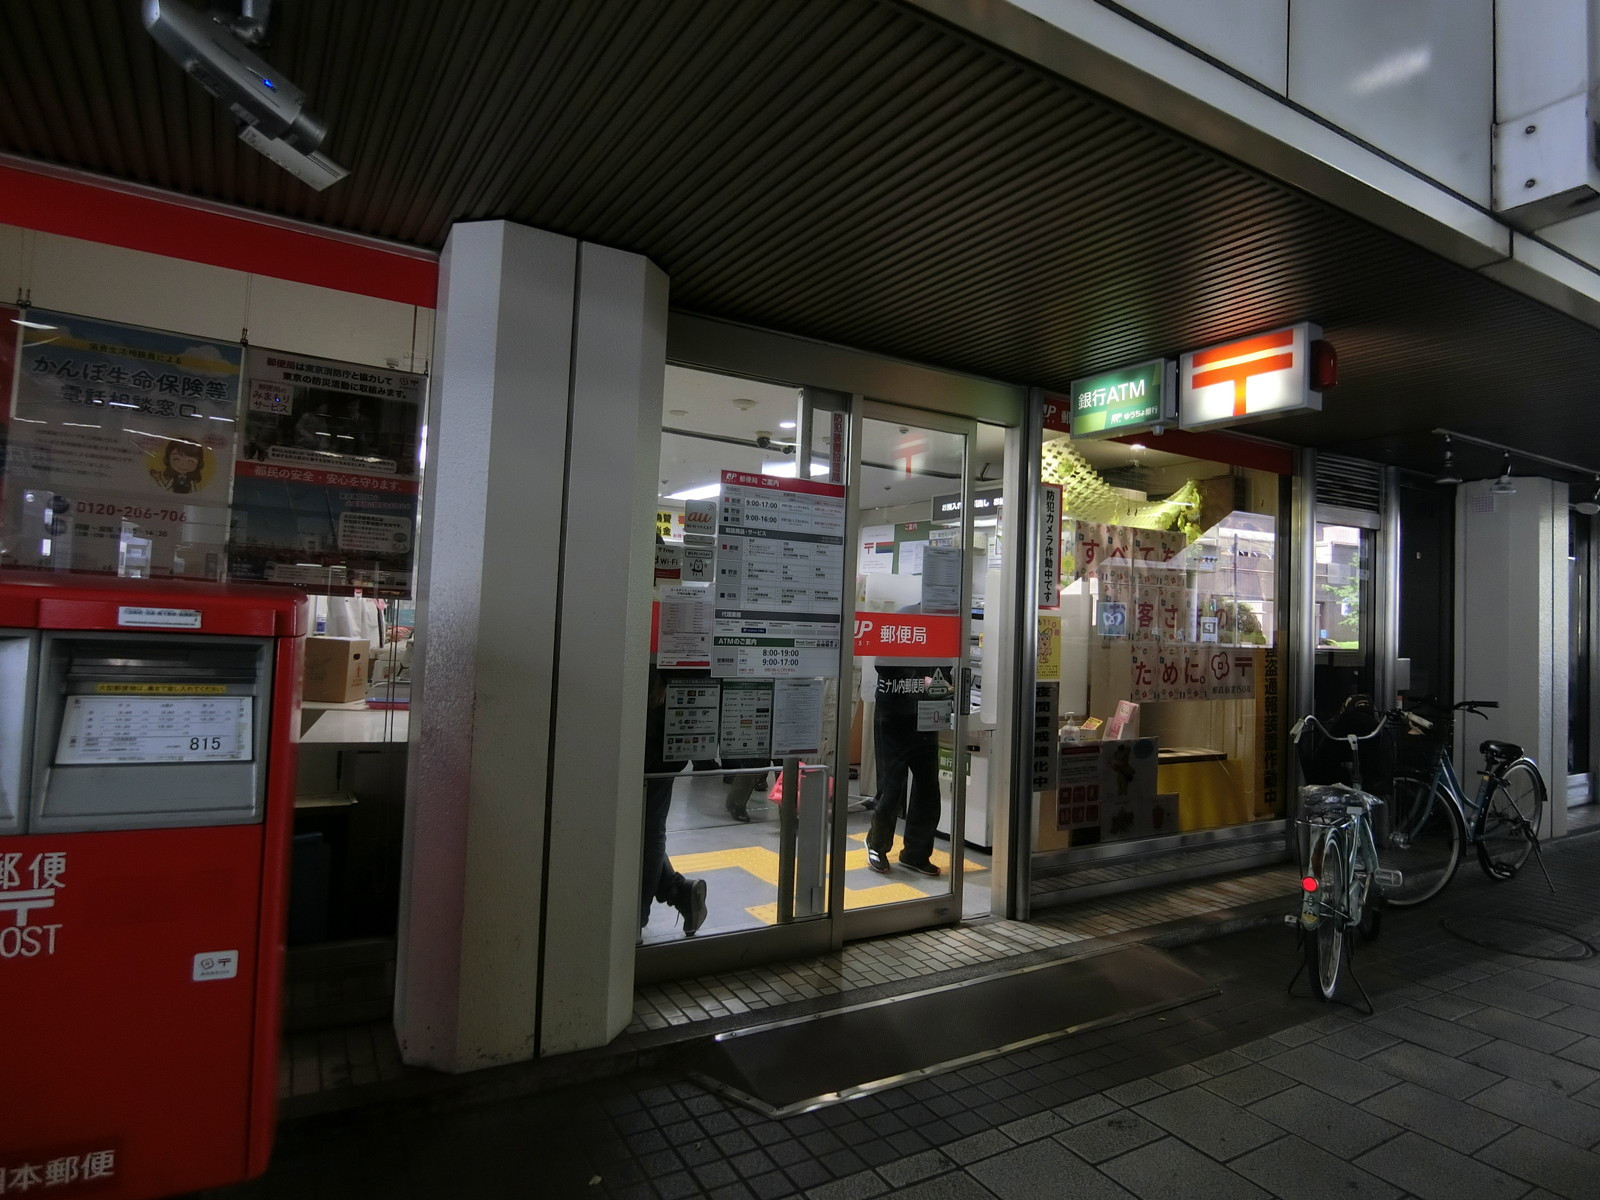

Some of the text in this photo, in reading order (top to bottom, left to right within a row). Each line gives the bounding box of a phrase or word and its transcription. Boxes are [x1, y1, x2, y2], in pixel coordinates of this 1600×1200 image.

[33, 356, 229, 400] かんぽ生命保険等
[282, 372, 407, 399] 東京の防災活動に取組みます。
[62, 384, 198, 418] 電話相談窓口
[1078, 379, 1145, 410] 銀行ATM
[254, 400, 289, 413] サービス
[1123, 406, 1158, 420] ゆうちょ銀行
[254, 465, 402, 491] 都民の安全・安心を守ります。
[739, 476, 758, 485] 郵便局
[761, 479, 780, 487] ご案内
[77, 501, 188, 523] 0120-206-706
[746, 500, 778, 509] 9:00-17:00
[687, 511, 712, 523] au
[745, 514, 778, 523] 9:00-16:00
[1044, 489, 1055, 603] 防犯カメラ作動中です
[718, 638, 757, 646] ATMのご案内
[880, 625, 927, 645] 郵便局
[762, 649, 800, 657] 8:00-19:00
[762, 658, 799, 666] 9:00-17:00
[1136, 662, 1205, 686] ために。
[878, 678, 925, 694] ミナル内郵便局
[189, 737, 222, 752] 815
[1033, 685, 1051, 788] 夜間警戒強化中
